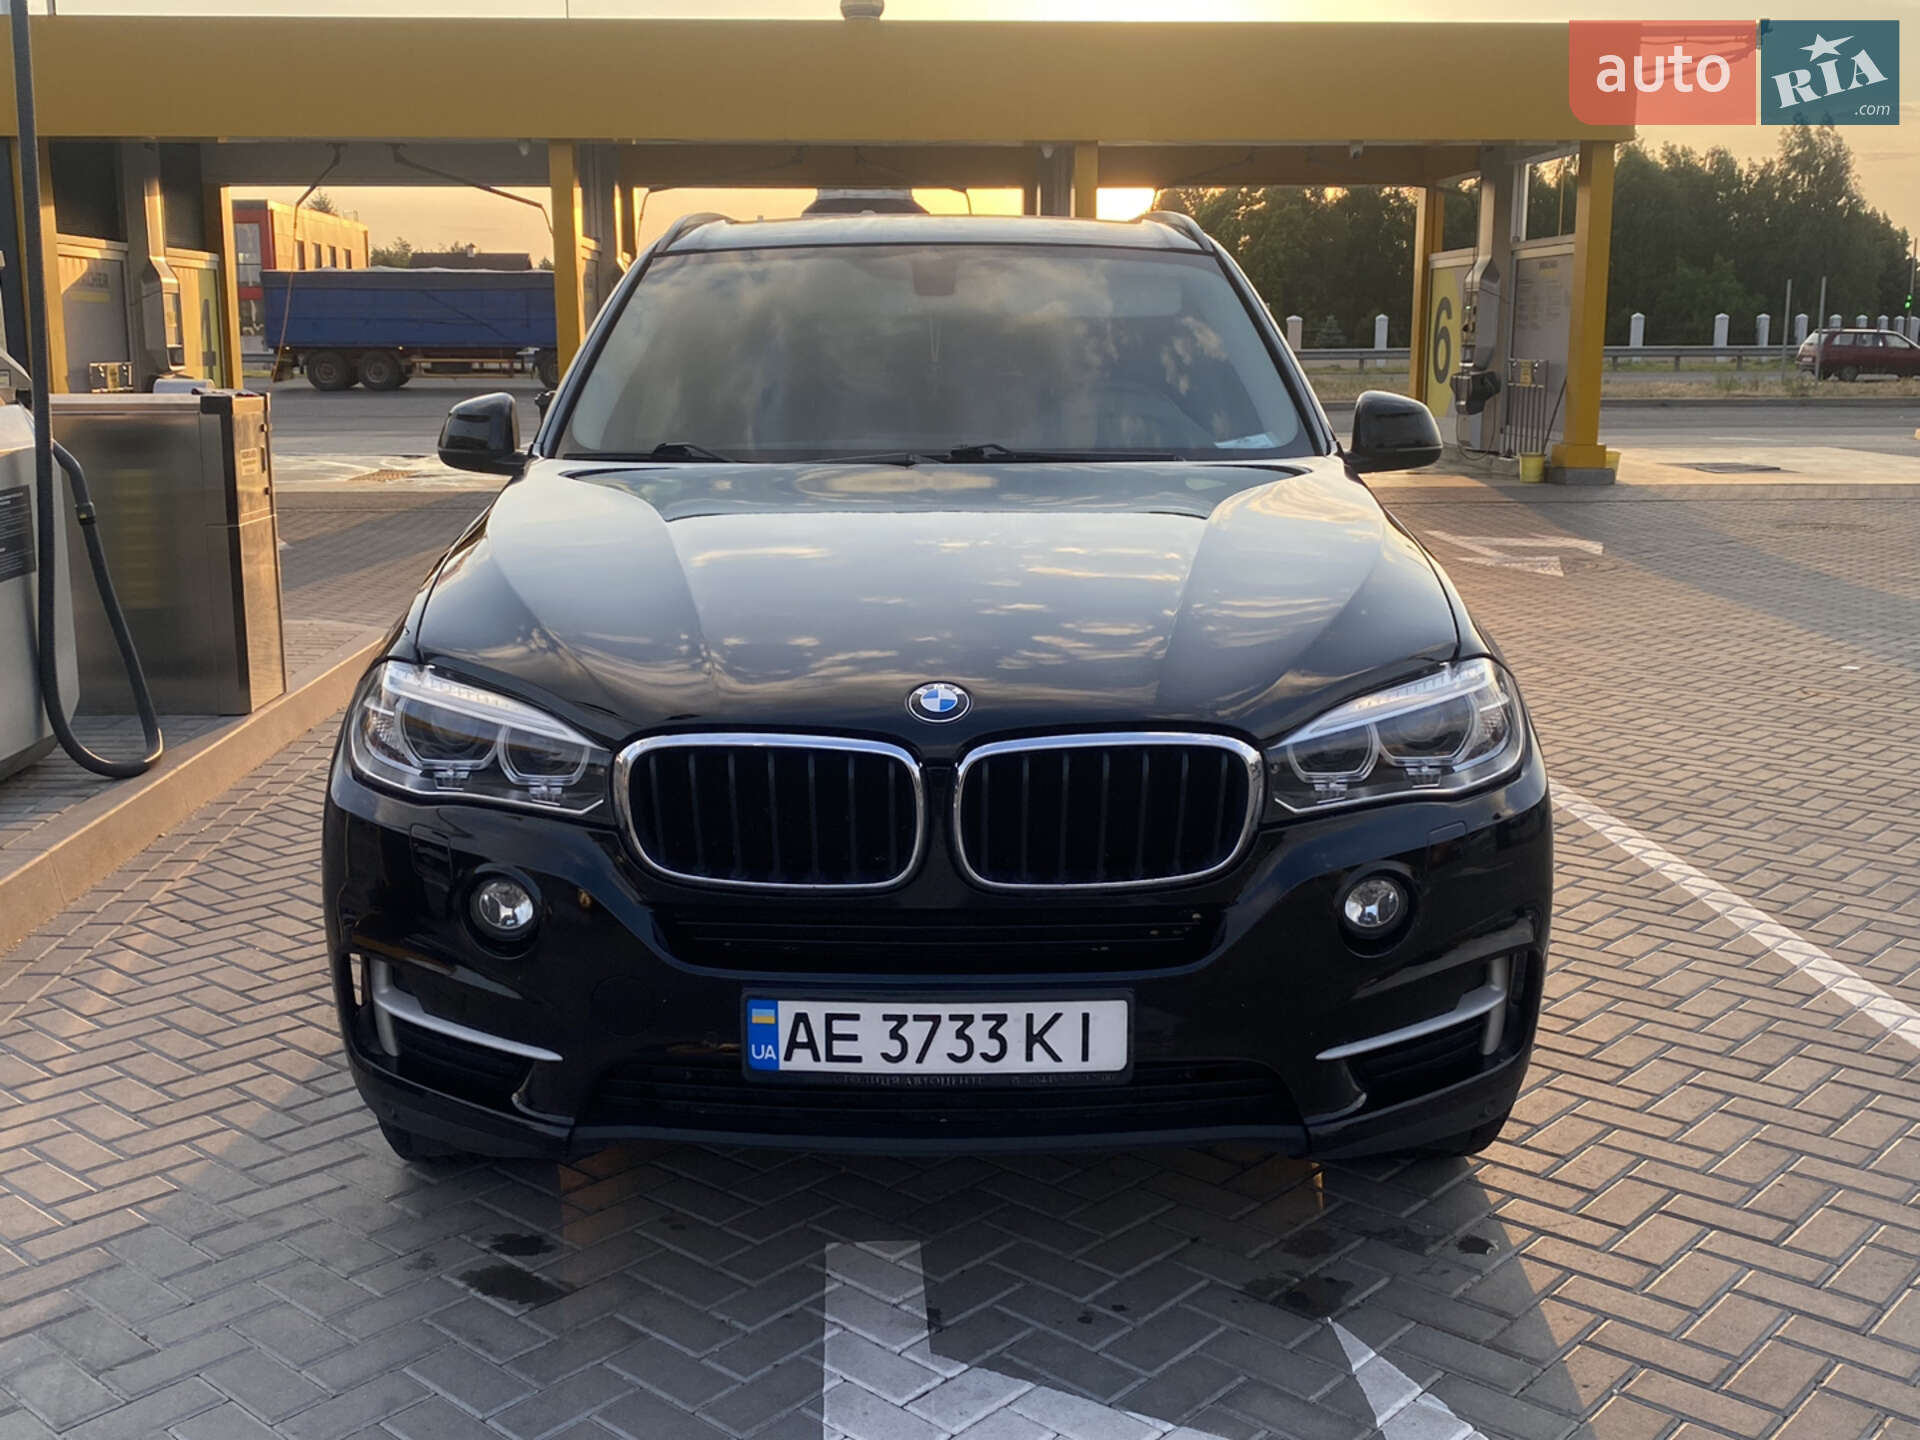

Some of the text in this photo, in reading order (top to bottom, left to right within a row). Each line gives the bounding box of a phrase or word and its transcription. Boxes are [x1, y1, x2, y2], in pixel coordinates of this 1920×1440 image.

[201, 299, 217, 381] 4
[1432, 296, 1452, 385] 6
[751, 1044, 777, 1060] UA
[783, 1012, 1091, 1064] AE 3733 KI
